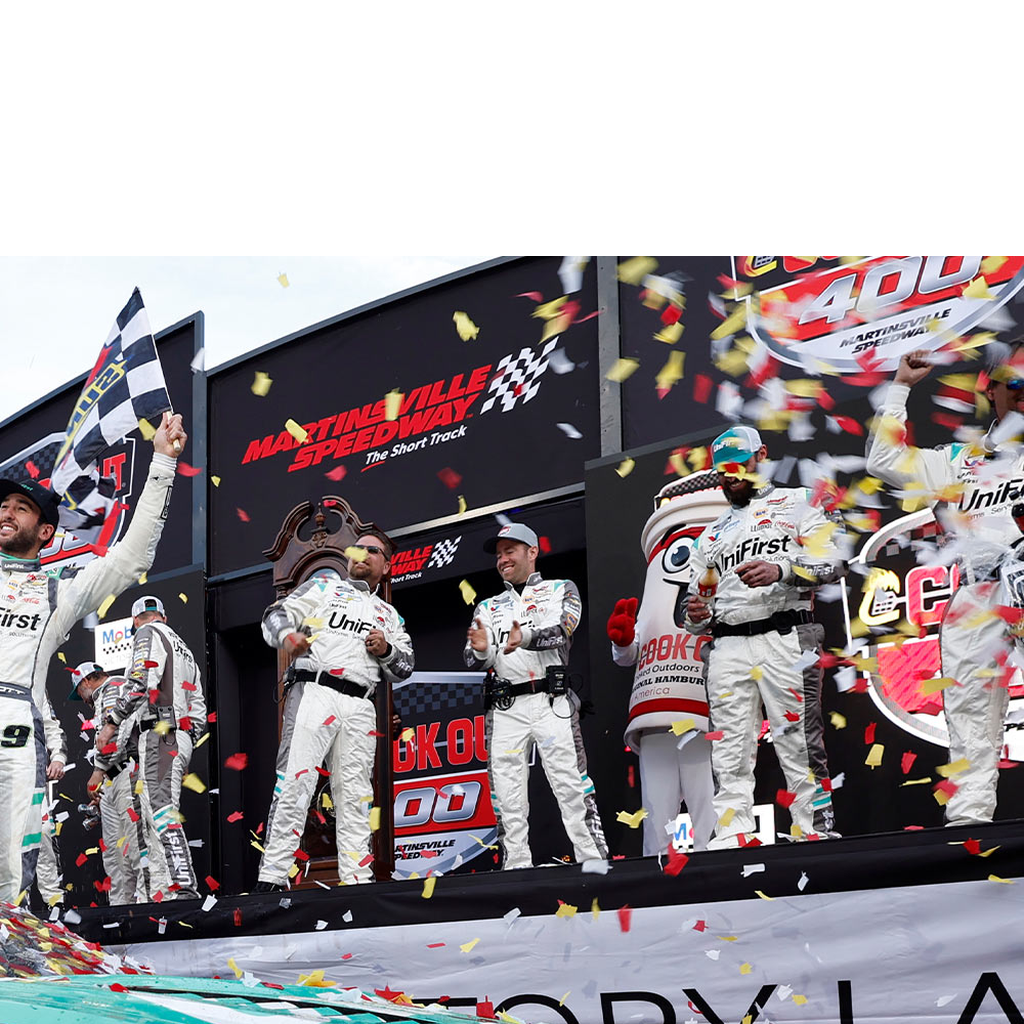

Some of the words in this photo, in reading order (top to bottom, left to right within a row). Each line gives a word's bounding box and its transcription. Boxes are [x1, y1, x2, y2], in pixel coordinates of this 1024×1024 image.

[838, 308, 952, 348] MARTINSVILLE
[851, 323, 938, 354] SPEEDWA
[241, 364, 493, 465] MARTINSVILLE
[288, 393, 480, 472] SPEEDWAY
[365, 449, 389, 466] The
[390, 437, 427, 459] Short
[429, 424, 467, 448] Track
[103, 626, 132, 644] Mob
[639, 633, 692, 672] COOK
[652, 662, 700, 674] Outdoors
[0, 725, 32, 748] 9
[394, 781, 482, 828] 00
